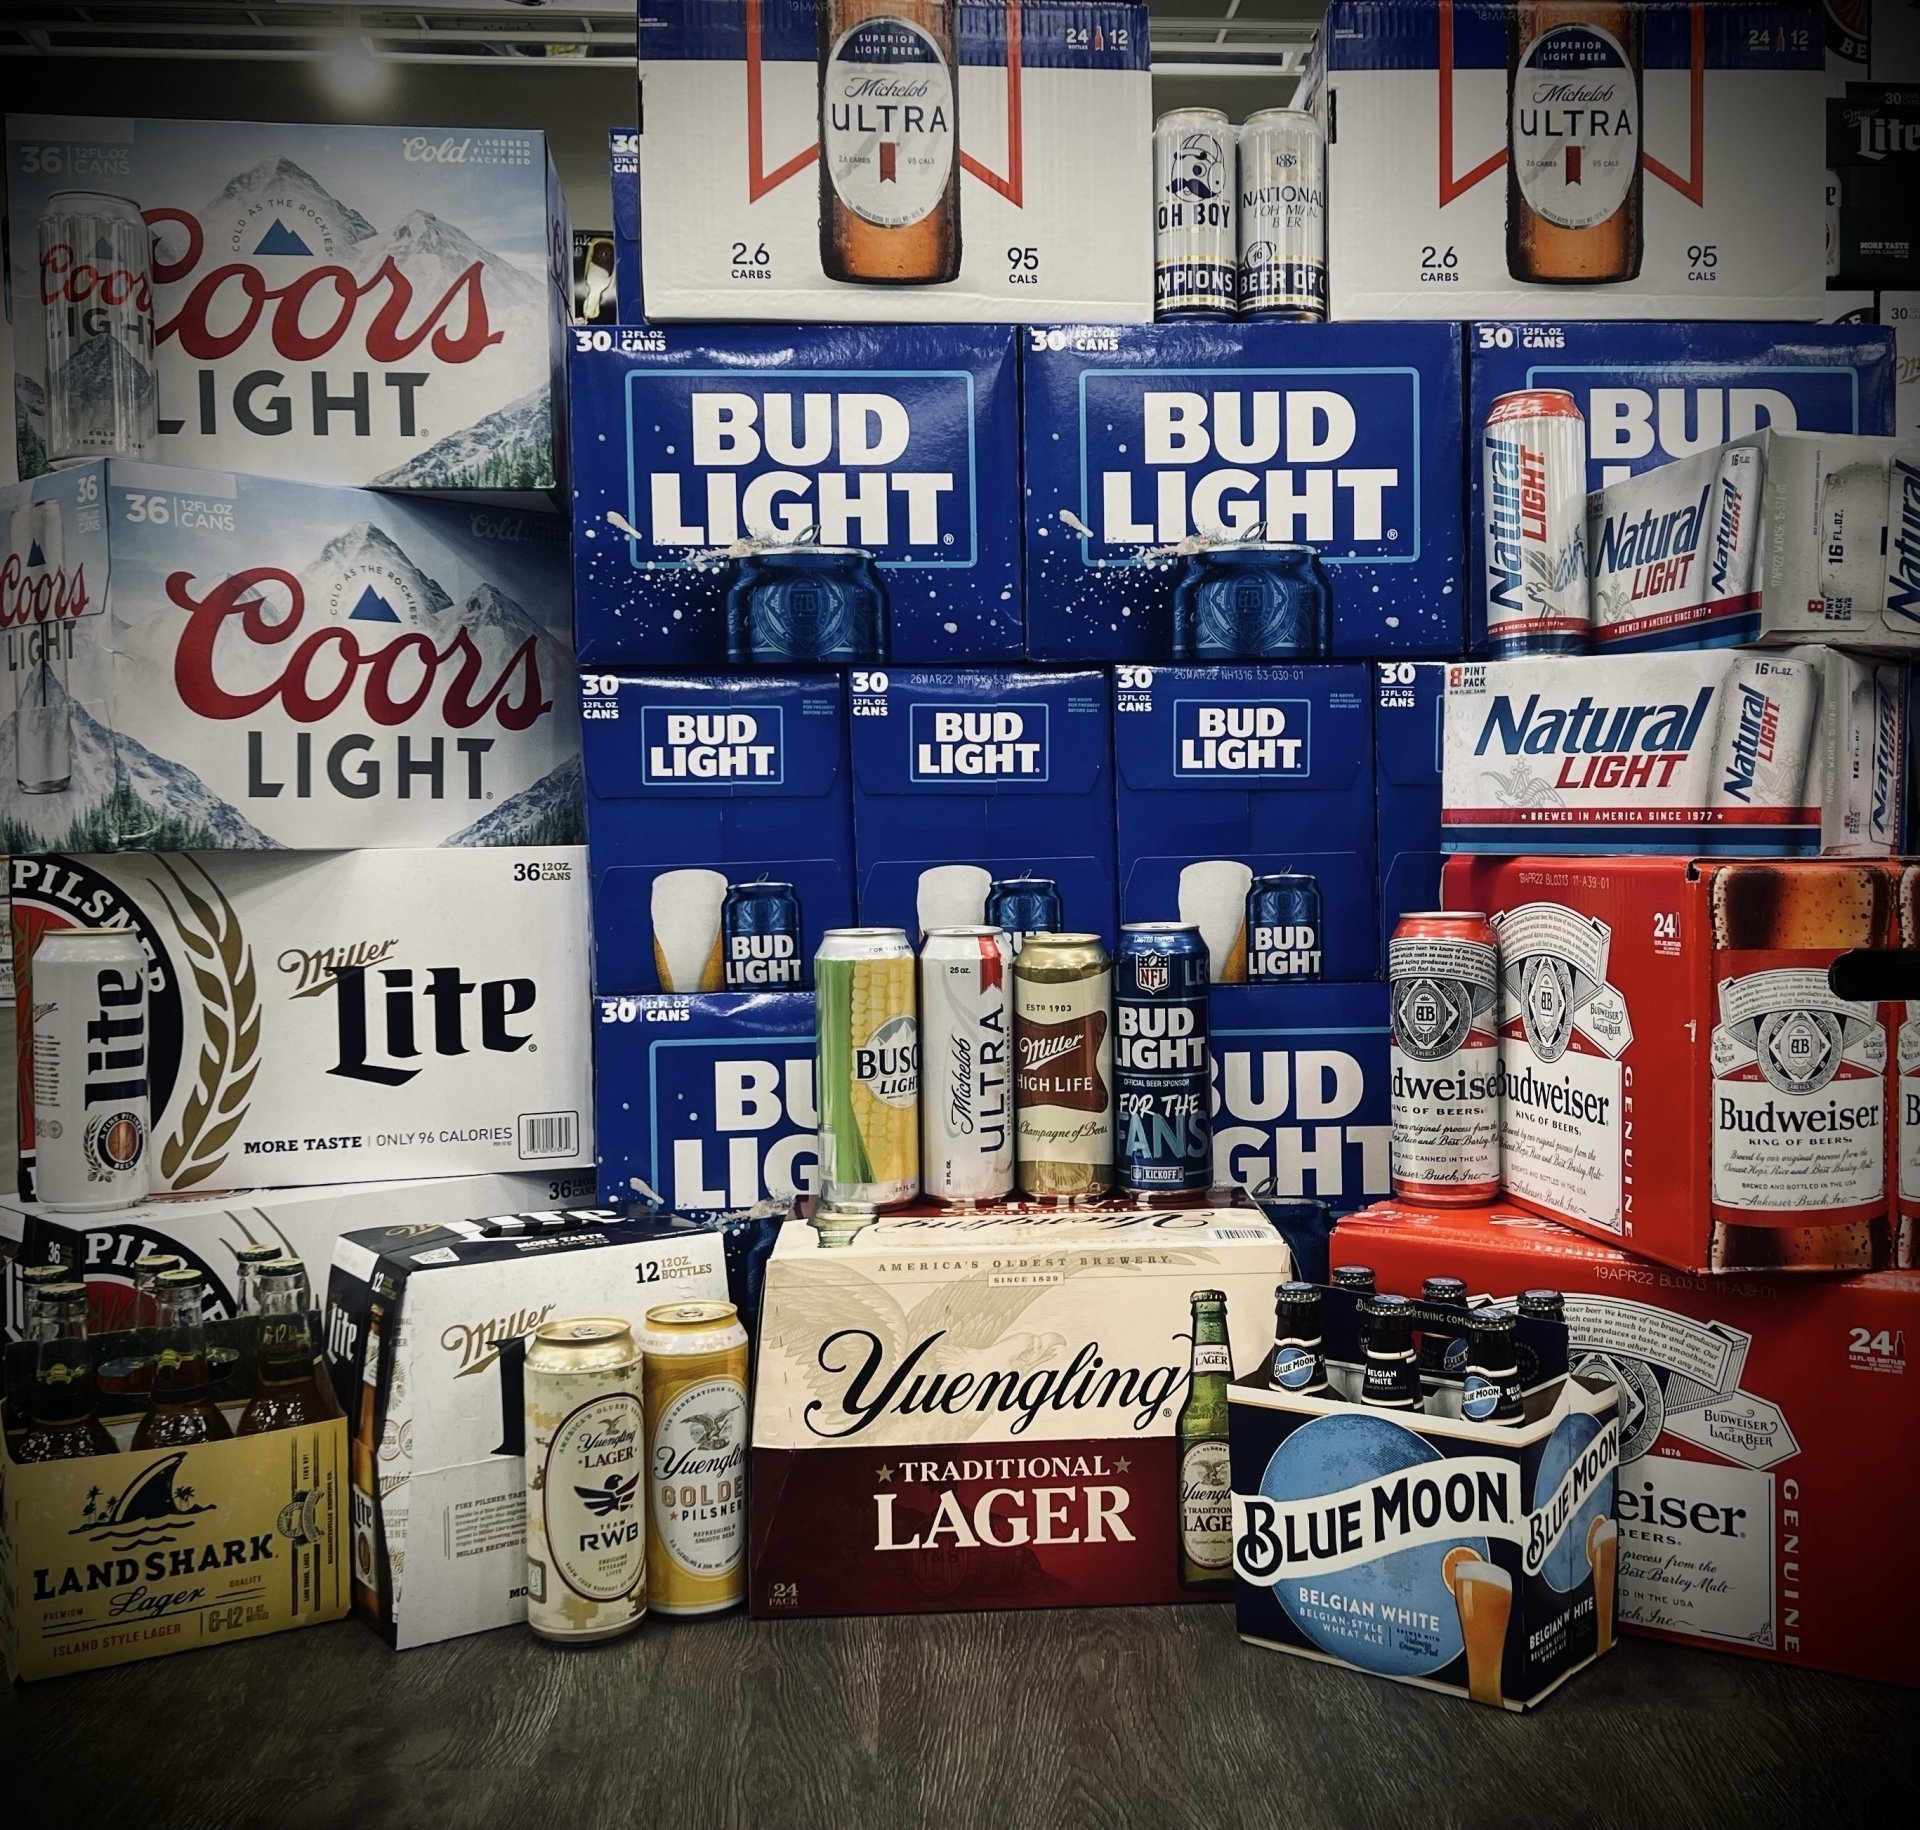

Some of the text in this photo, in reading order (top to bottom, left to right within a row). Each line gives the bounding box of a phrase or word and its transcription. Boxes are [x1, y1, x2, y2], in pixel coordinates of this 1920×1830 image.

[858, 33, 915, 45] SUPERIOR
[1066, 28, 1129, 44] 24 12
[854, 45, 921, 56] LIGHT BEER
[844, 77, 928, 98] Michelob
[1532, 84, 1614, 104] Michelob
[832, 103, 948, 133] ULTRA
[1520, 110, 1632, 137] ULTRA
[402, 137, 470, 164] Cold
[474, 148, 530, 156] FILTERED
[478, 139, 530, 148] LAGERED
[1857, 117, 1920, 160] Lite
[20, 146, 62, 174] 36
[75, 161, 130, 175] CANS
[469, 157, 530, 165] PACKAGED
[1243, 186, 1323, 208] NATIONAL
[233, 199, 332, 254] COLD AS THE ROCKIES
[1158, 202, 1230, 230] OH BOY
[732, 242, 770, 266] 2.6
[1007, 247, 1039, 270] 95
[1421, 247, 1457, 268] 2.6
[1687, 247, 1718, 268] 95
[731, 269, 772, 280] CARBS
[1008, 273, 1039, 285] CALS
[1158, 270, 1233, 294] MPIONS
[1240, 270, 1286, 294] BEER
[576, 331, 611, 352] 30
[622, 339, 666, 352] CANS
[1478, 328, 1513, 349] 30
[691, 392, 910, 466] BUD
[1144, 390, 1356, 464] BUD
[1589, 388, 1798, 459] BUD
[650, 470, 953, 546] LIGHT
[1103, 468, 1398, 543] LIGHT
[1521, 446, 1546, 544] LIGHT
[126, 495, 169, 524] 36
[181, 515, 235, 532] CANS
[1486, 438, 1523, 611] Natural
[1594, 484, 1711, 578] Natural
[0, 552, 89, 629] Coors
[1630, 554, 1695, 601] LIGHT
[8, 620, 76, 671] LIGHT
[165, 567, 553, 731] Coors
[583, 675, 620, 696] 30
[1118, 668, 1152, 688] 30
[1221, 669, 1253, 681] NH1316
[1256, 669, 1304, 681] 53-030-01
[1449, 667, 1486, 688] 8 PINT
[1464, 677, 1487, 688] PACK
[583, 710, 619, 720] CANS
[935, 711, 1023, 743] BUD
[1473, 686, 1715, 756] Natural
[667, 714, 757, 745] BUD
[1724, 682, 1768, 803] Natural
[1758, 697, 1781, 763] LIGHT
[247, 731, 496, 800] LIGHT
[650, 746, 775, 777] LIGHT
[918, 743, 1040, 775] LIGHT
[1555, 754, 1688, 789] LIGHT
[1531, 811, 1714, 821] BREWED IN AMERICA SINCE 1977
[514, 862, 540, 882] 36
[541, 871, 571, 882] CANS
[732, 935, 794, 960] BUD
[277, 938, 400, 1000] Miller
[726, 959, 801, 984] LIGHT
[1140, 968, 1166, 987] NFL
[326, 965, 537, 1086] Lite
[1118, 1007, 1194, 1036] BUD
[1020, 1034, 1084, 1071] Miller
[1115, 1037, 1205, 1069] LIGHT
[951, 1033, 974, 1135] Michelob
[979, 1003, 1005, 1154] ULTRA
[1017, 1074, 1093, 1092] HIGH LIFE
[1124, 1078, 1190, 1087] OFFICIAL BEER SPONSOR
[1497, 1058, 1609, 1126] Budweiser
[1119, 1093, 1200, 1116] FOR THE
[1720, 1097, 1878, 1132] Budweiser
[244, 1127, 513, 1155] MORE TASTE ONLY 96 CALORIES
[1019, 1122, 1071, 1143] Champagne
[1749, 1138, 1802, 1147] KING OF
[1624, 1066, 1633, 1238] GENUINE
[1145, 1169, 1177, 1179] KICKOFF
[636, 1262, 660, 1284] 12
[661, 1263, 712, 1280] BOTTLES
[878, 1260, 980, 1272] AMERICA'S
[992, 1258, 1067, 1269] OLDEST
[1593, 1266, 1653, 1285] 19APR22
[993, 1274, 1060, 1284] SINCE 1829
[327, 1307, 357, 1363] Lite
[441, 1302, 556, 1379] Miller
[1617, 1310, 1722, 1352] know brand produced
[1848, 1328, 1893, 1356] 24
[1195, 1354, 1228, 1366] LAGER
[1669, 1345, 1717, 1370] smoothness
[803, 1330, 1192, 1438] Yuengling
[1367, 1369, 1397, 1379] BELGIAN
[1369, 1377, 1393, 1386] WHITE
[1704, 1409, 1769, 1431] BUDWEISER
[577, 1423, 637, 1453] Yuengling
[585, 1446, 634, 1469] LAGER
[899, 1455, 1111, 1485] TRADITIONAL
[1571, 1425, 1618, 1504] MOON
[661, 1476, 743, 1507] GOLDE
[682, 1500, 743, 1521] PILSNER
[874, 1484, 1136, 1551] LAGER
[1371, 1470, 1508, 1543] MOON
[1617, 1481, 1747, 1538] eiser
[580, 1523, 638, 1551] RWB
[600, 1519, 626, 1529] TEAM
[1526, 1492, 1569, 1571] BLUE
[1236, 1500, 1362, 1577] BLUE
[1622, 1551, 1694, 1570] process from
[1783, 1478, 1800, 1652] GENUINE
[229, 1575, 263, 1588] QUALITY
[773, 1583, 799, 1598] 24
[109, 1586, 205, 1616] Lager
[1299, 1587, 1440, 1632] BELGIAN WHITE
[1650, 1593, 1694, 1608] THE USA
[43, 1608, 83, 1621] PREMIUM
[208, 1607, 243, 1633] 6-12
[1300, 1607, 1384, 1634] BELGIAN-STYLE
[54, 1623, 181, 1657] ISLAND STYLE LAGER
[1323, 1623, 1384, 1645] WHEAT ALE
[1530, 1619, 1562, 1650] BELGIAN
